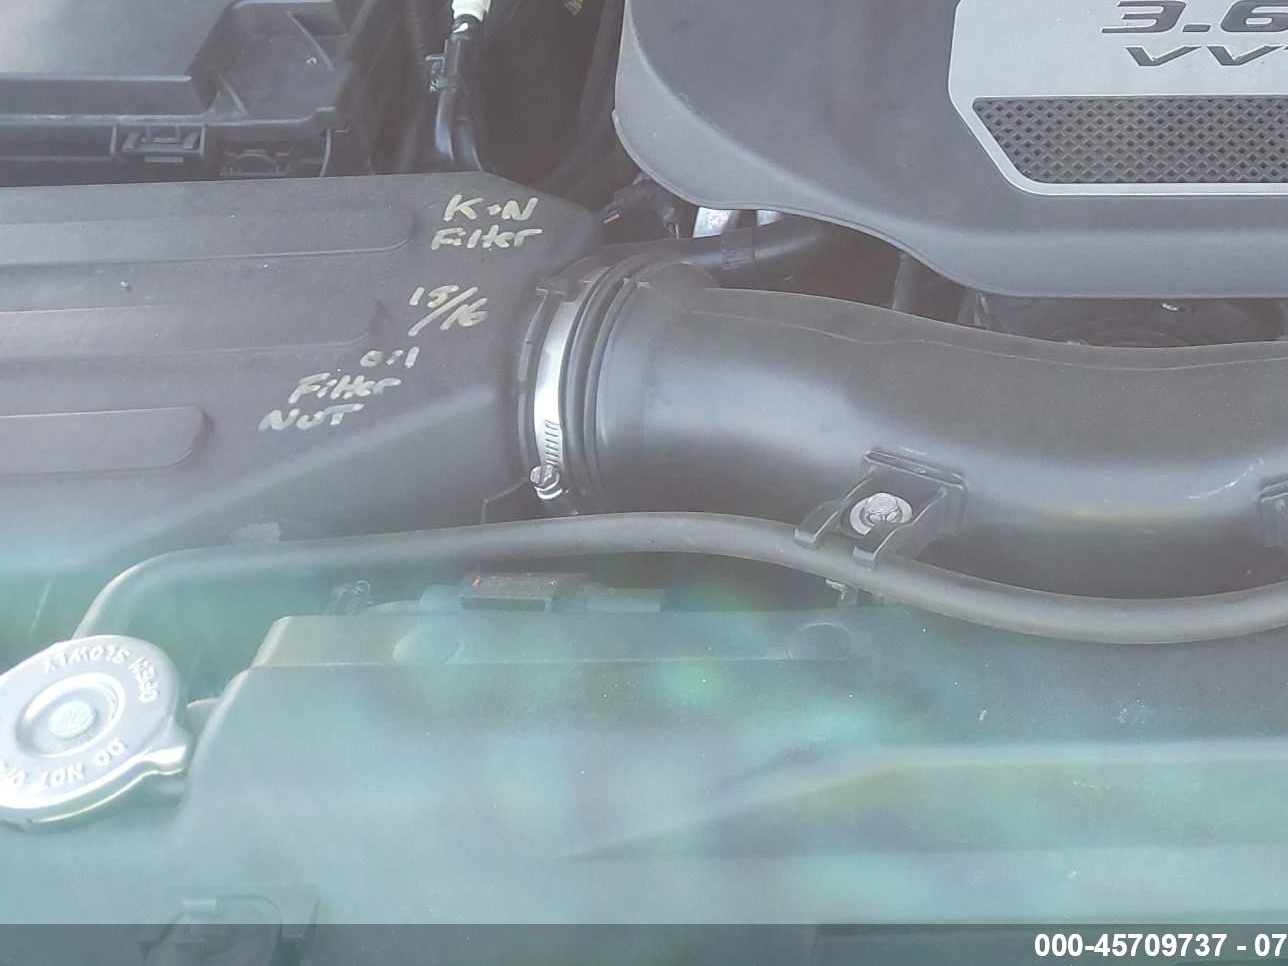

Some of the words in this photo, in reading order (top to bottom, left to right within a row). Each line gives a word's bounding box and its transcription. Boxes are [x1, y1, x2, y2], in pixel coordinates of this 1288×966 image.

[46, 645, 130, 673] SLOWLY
[131, 657, 160, 703] OPEN
[96, 738, 127, 766] DO
[42, 762, 86, 788] NOT
